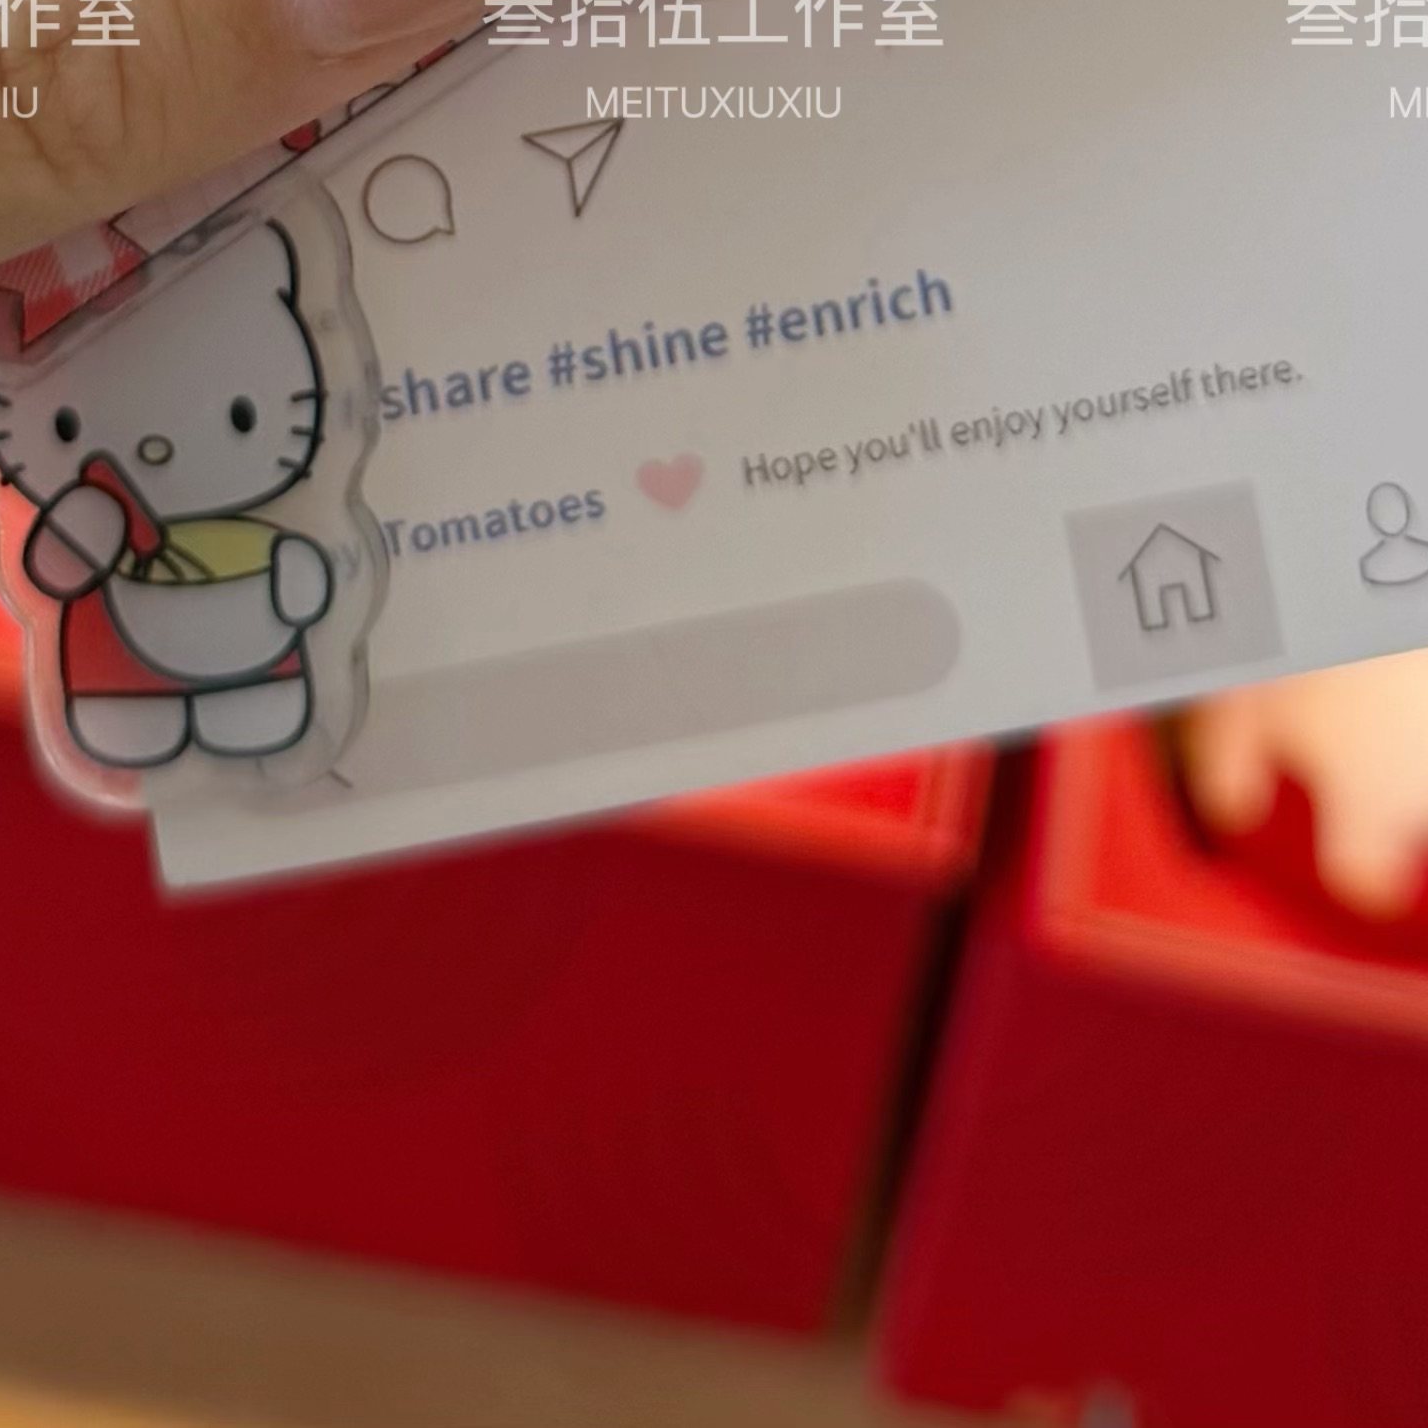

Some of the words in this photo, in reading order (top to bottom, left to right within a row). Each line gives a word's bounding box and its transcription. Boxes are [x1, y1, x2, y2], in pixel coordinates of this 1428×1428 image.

[548, 316, 730, 388] #shine
[745, 269, 954, 346] #enrich
[742, 445, 838, 494] Hope
[845, 418, 943, 473] you'll
[950, 402, 1046, 450] enjoy
[1051, 365, 1197, 435] yourself
[1199, 355, 1305, 400] there.
[383, 485, 607, 557] Tomatoes
